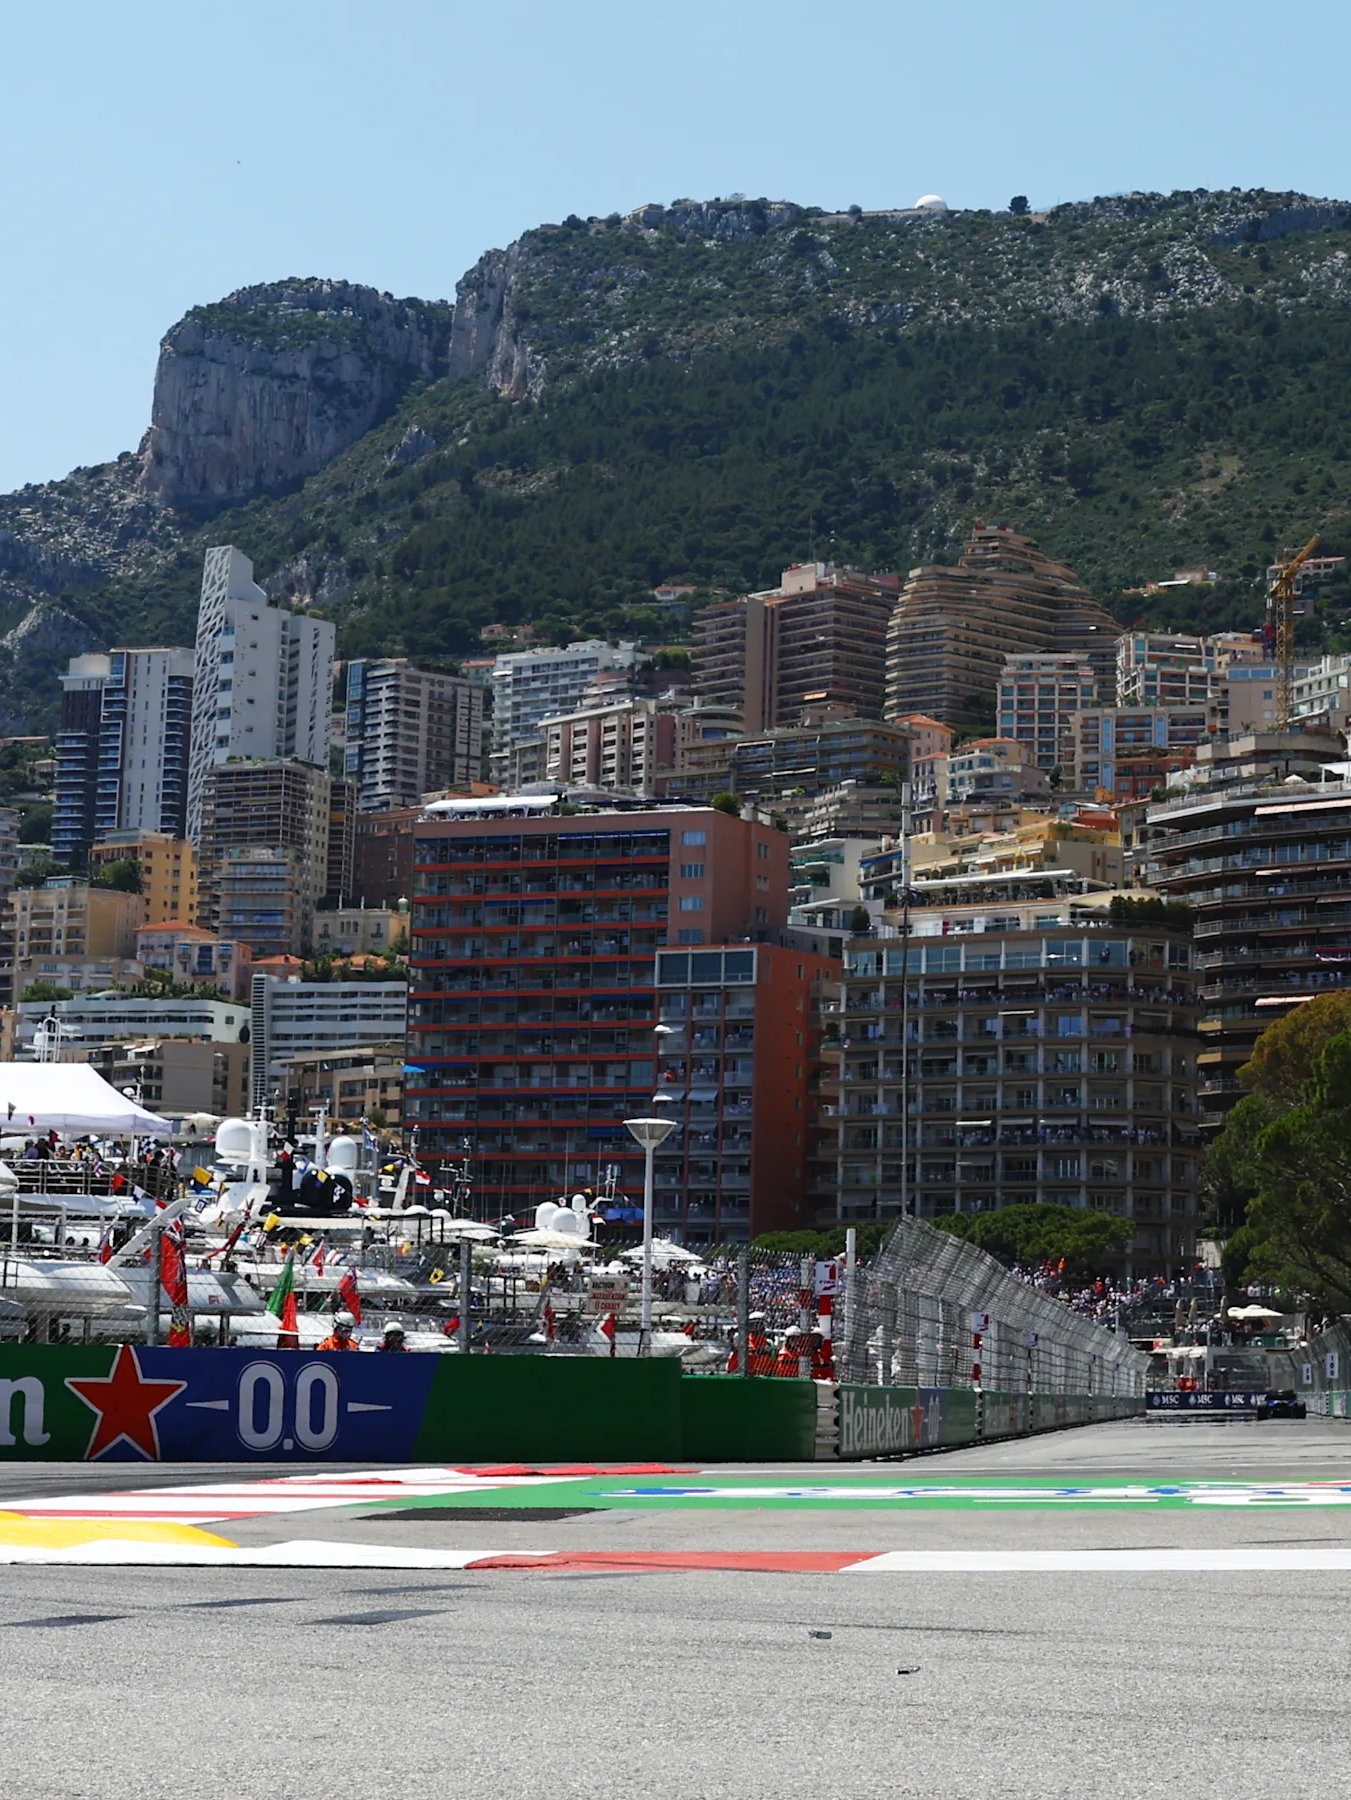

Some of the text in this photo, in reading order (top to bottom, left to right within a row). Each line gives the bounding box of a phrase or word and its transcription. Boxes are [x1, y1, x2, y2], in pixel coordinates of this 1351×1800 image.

[237, 1362, 340, 1451] 0.0
[841, 1391, 909, 1452] Heineken
[1162, 1394, 1180, 1405] MSC
